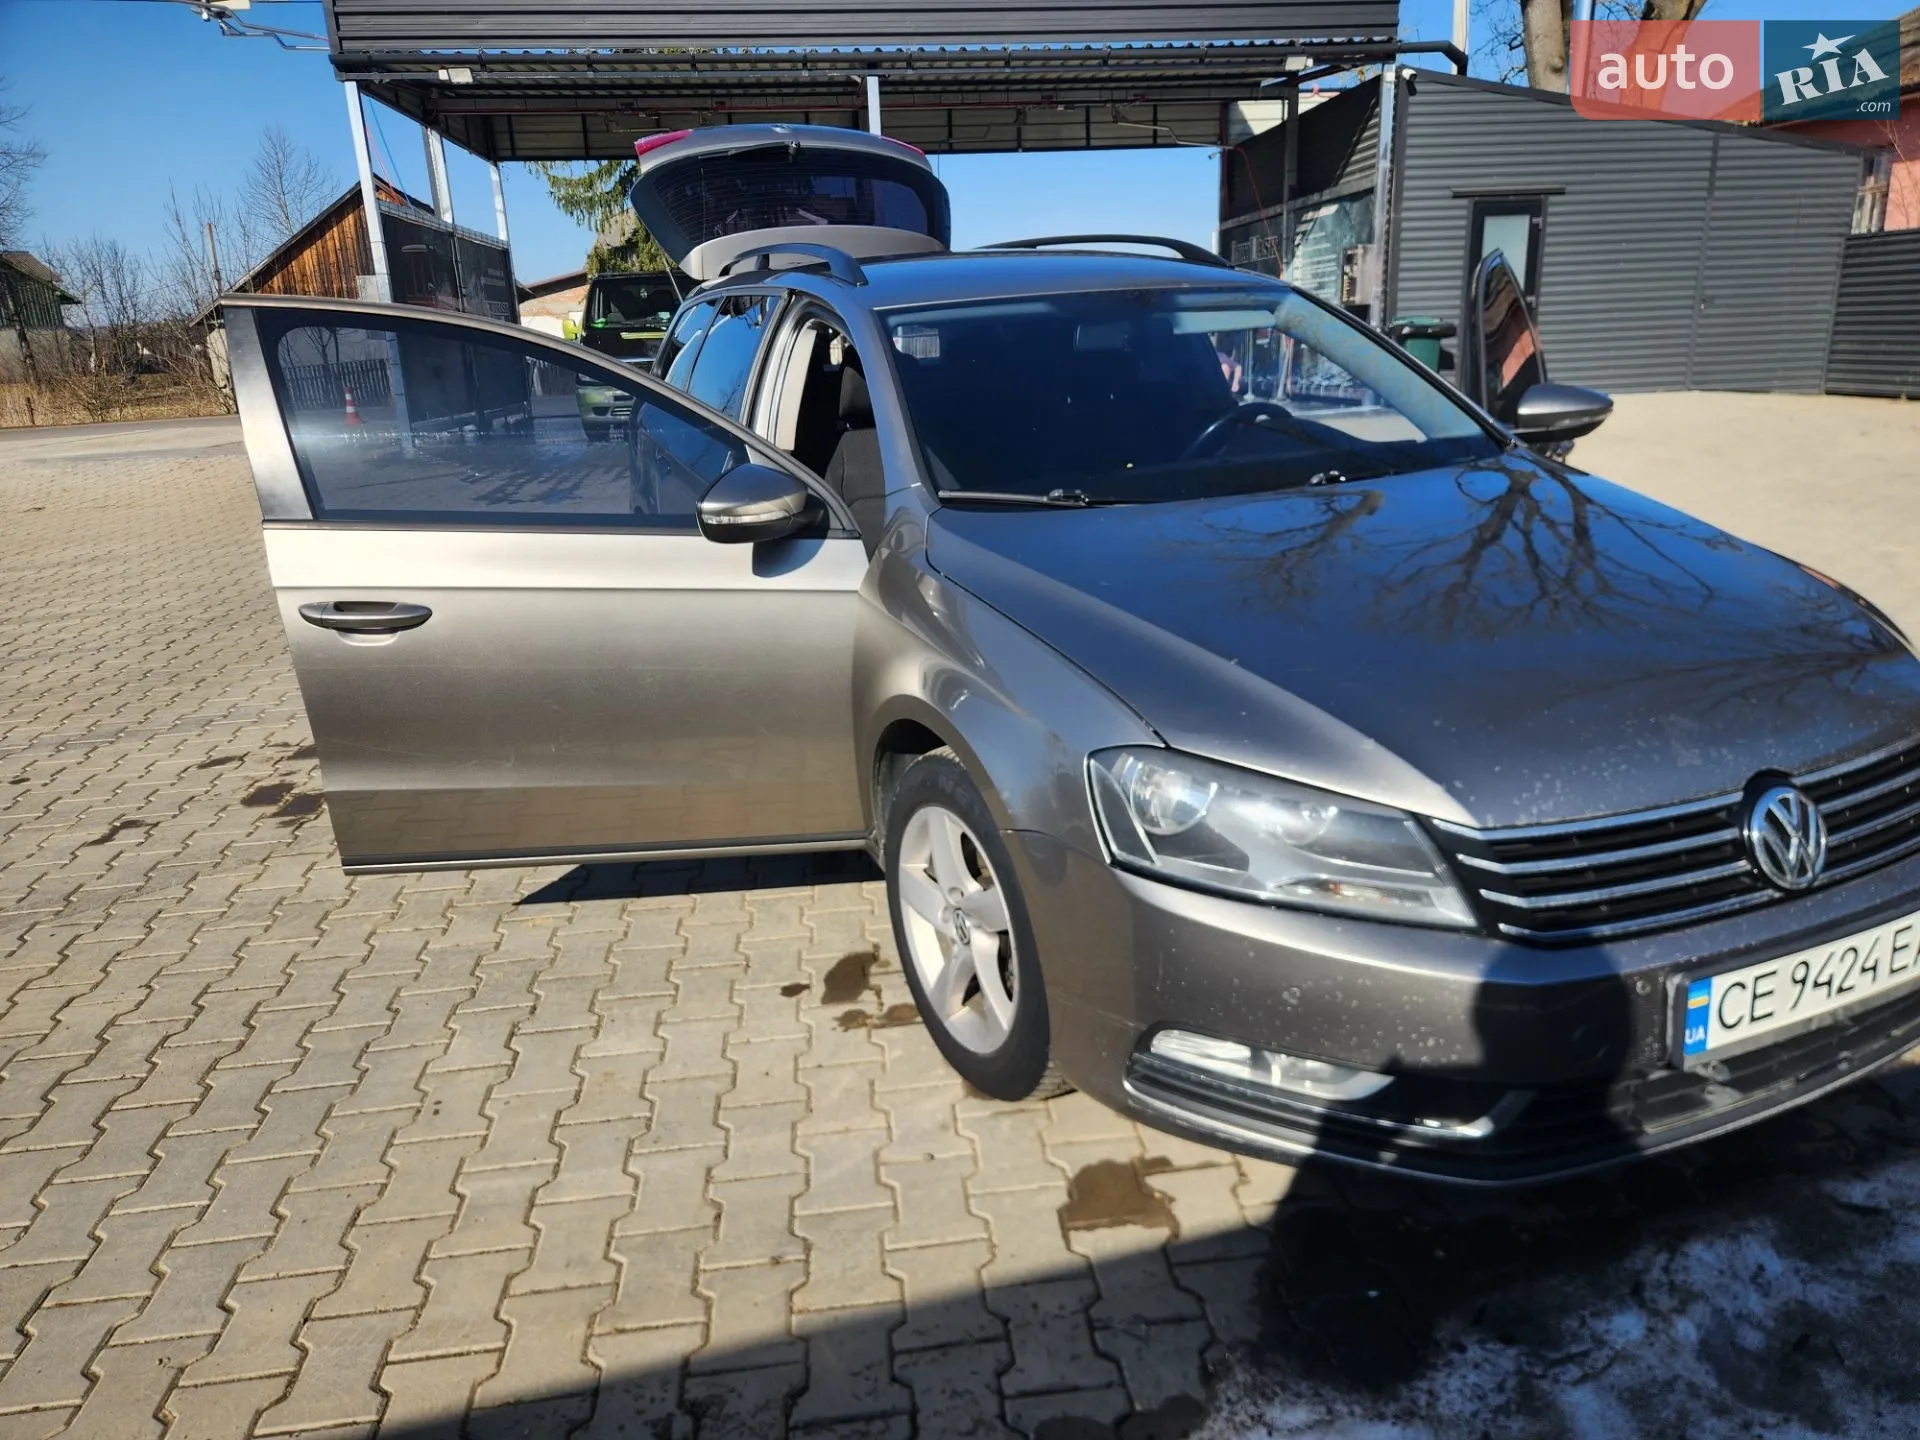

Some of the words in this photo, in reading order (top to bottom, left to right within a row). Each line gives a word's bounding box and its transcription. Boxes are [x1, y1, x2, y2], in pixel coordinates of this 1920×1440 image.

[1718, 970, 1779, 1030] CE
[1790, 936, 1882, 1013] 9424
[1889, 924, 1920, 976] E
[1684, 1026, 1706, 1045] UA
